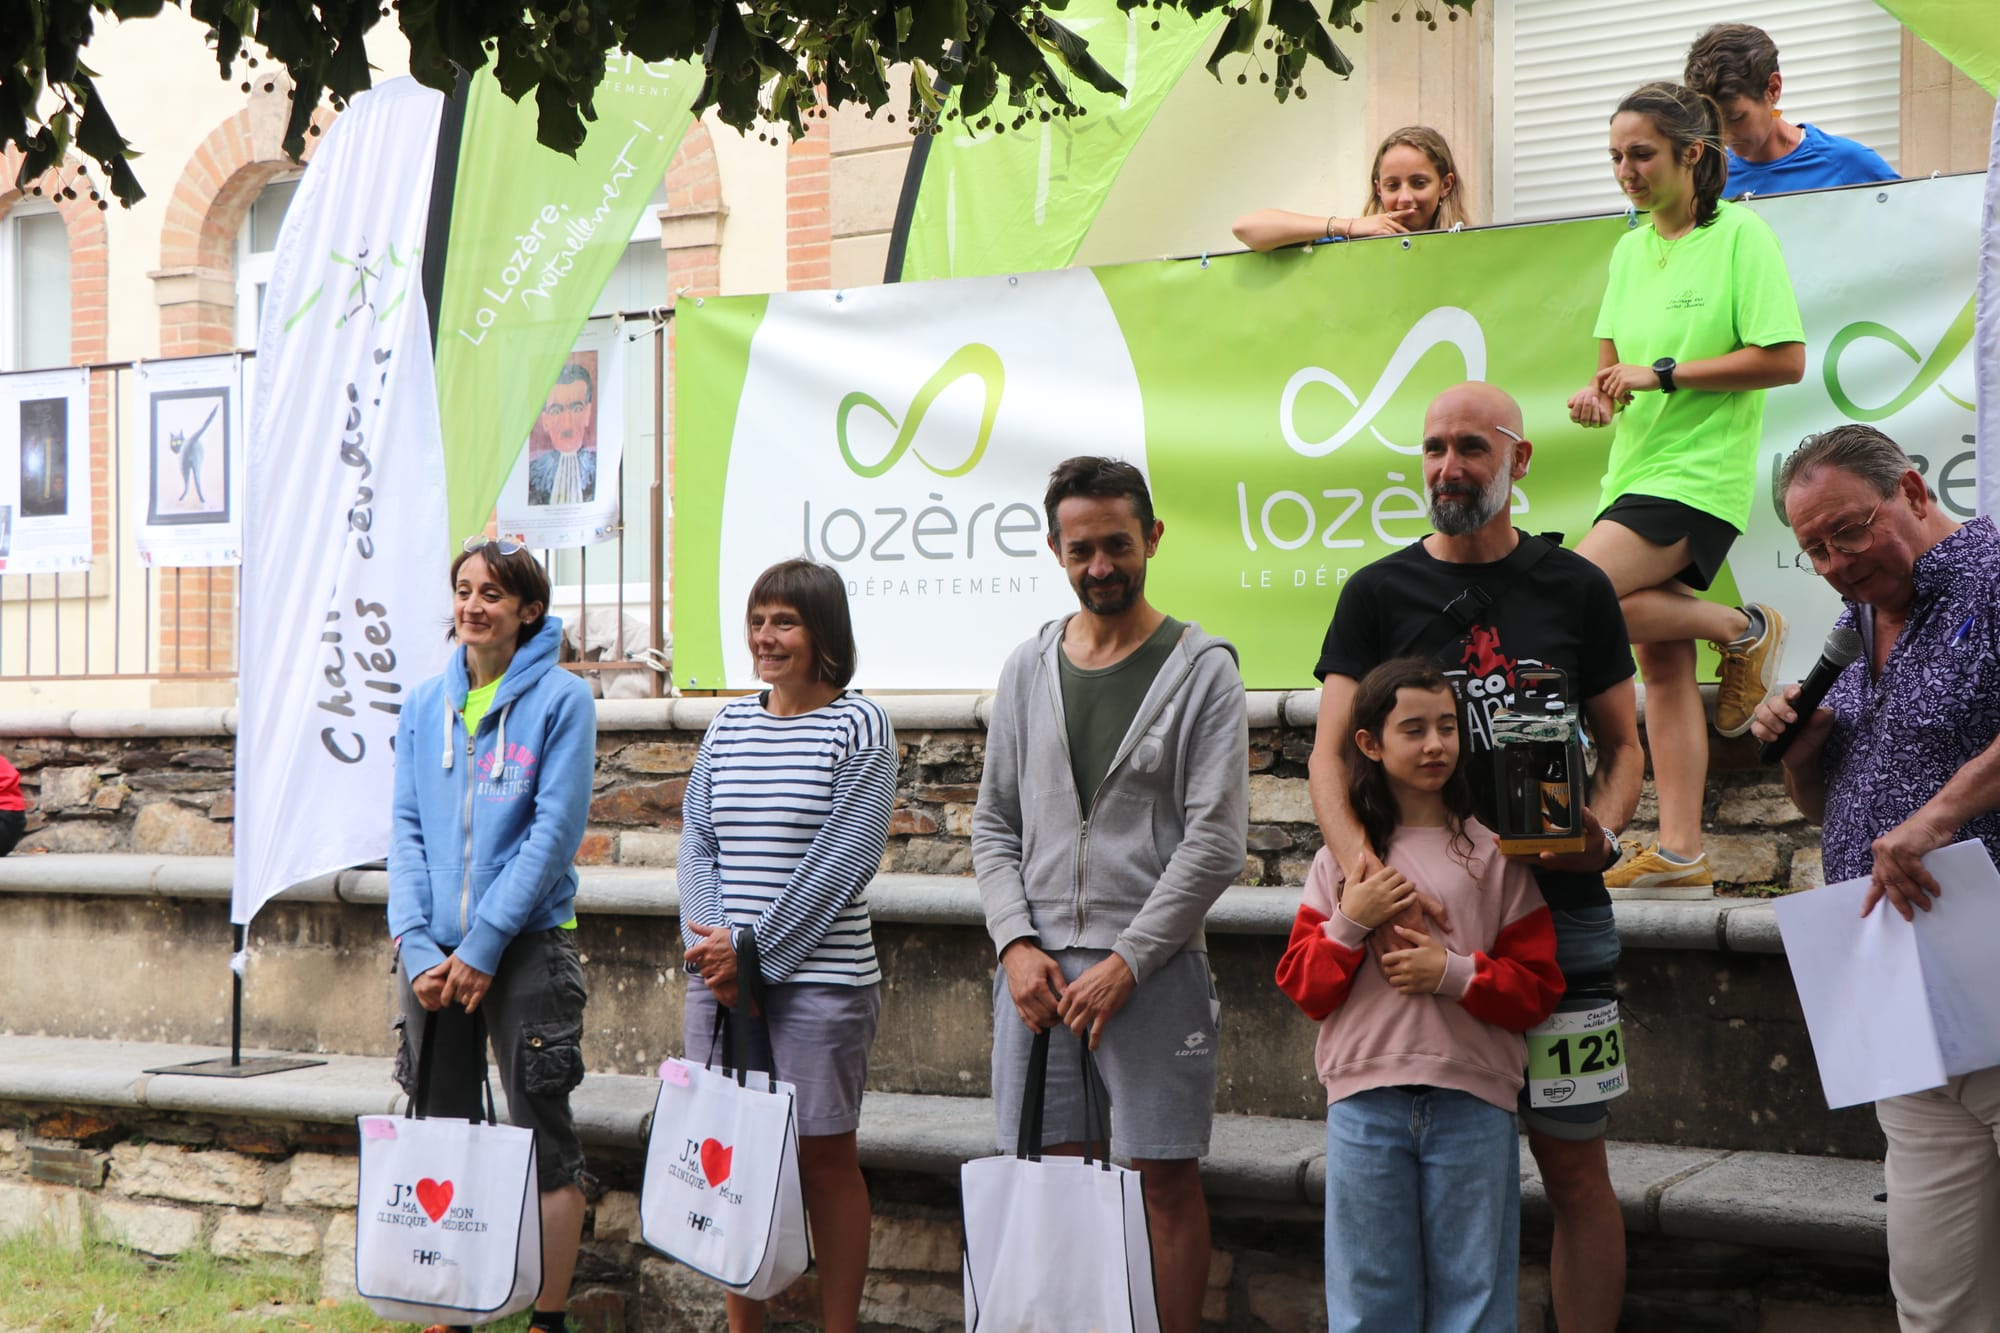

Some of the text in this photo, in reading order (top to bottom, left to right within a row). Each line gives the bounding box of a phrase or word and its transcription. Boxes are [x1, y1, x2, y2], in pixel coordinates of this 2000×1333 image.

[603, 80, 670, 97] TEMENT
[458, 203, 569, 346] La Lozère,
[803, 492, 1042, 562] lozère
[848, 576, 1039, 597] DÉPARTEMENT
[1241, 570, 1272, 588] LE
[1547, 1029, 1620, 1076] 123
[1543, 1086, 1571, 1097] BFP
[687, 1159, 700, 1174] MA
[667, 1163, 707, 1191] CLINIQUE
[401, 1201, 418, 1214] MA
[449, 1207, 474, 1220] MON
[376, 1211, 428, 1229] CLINIQUE
[686, 1210, 713, 1233] FHP
[412, 1249, 442, 1266] FHP
